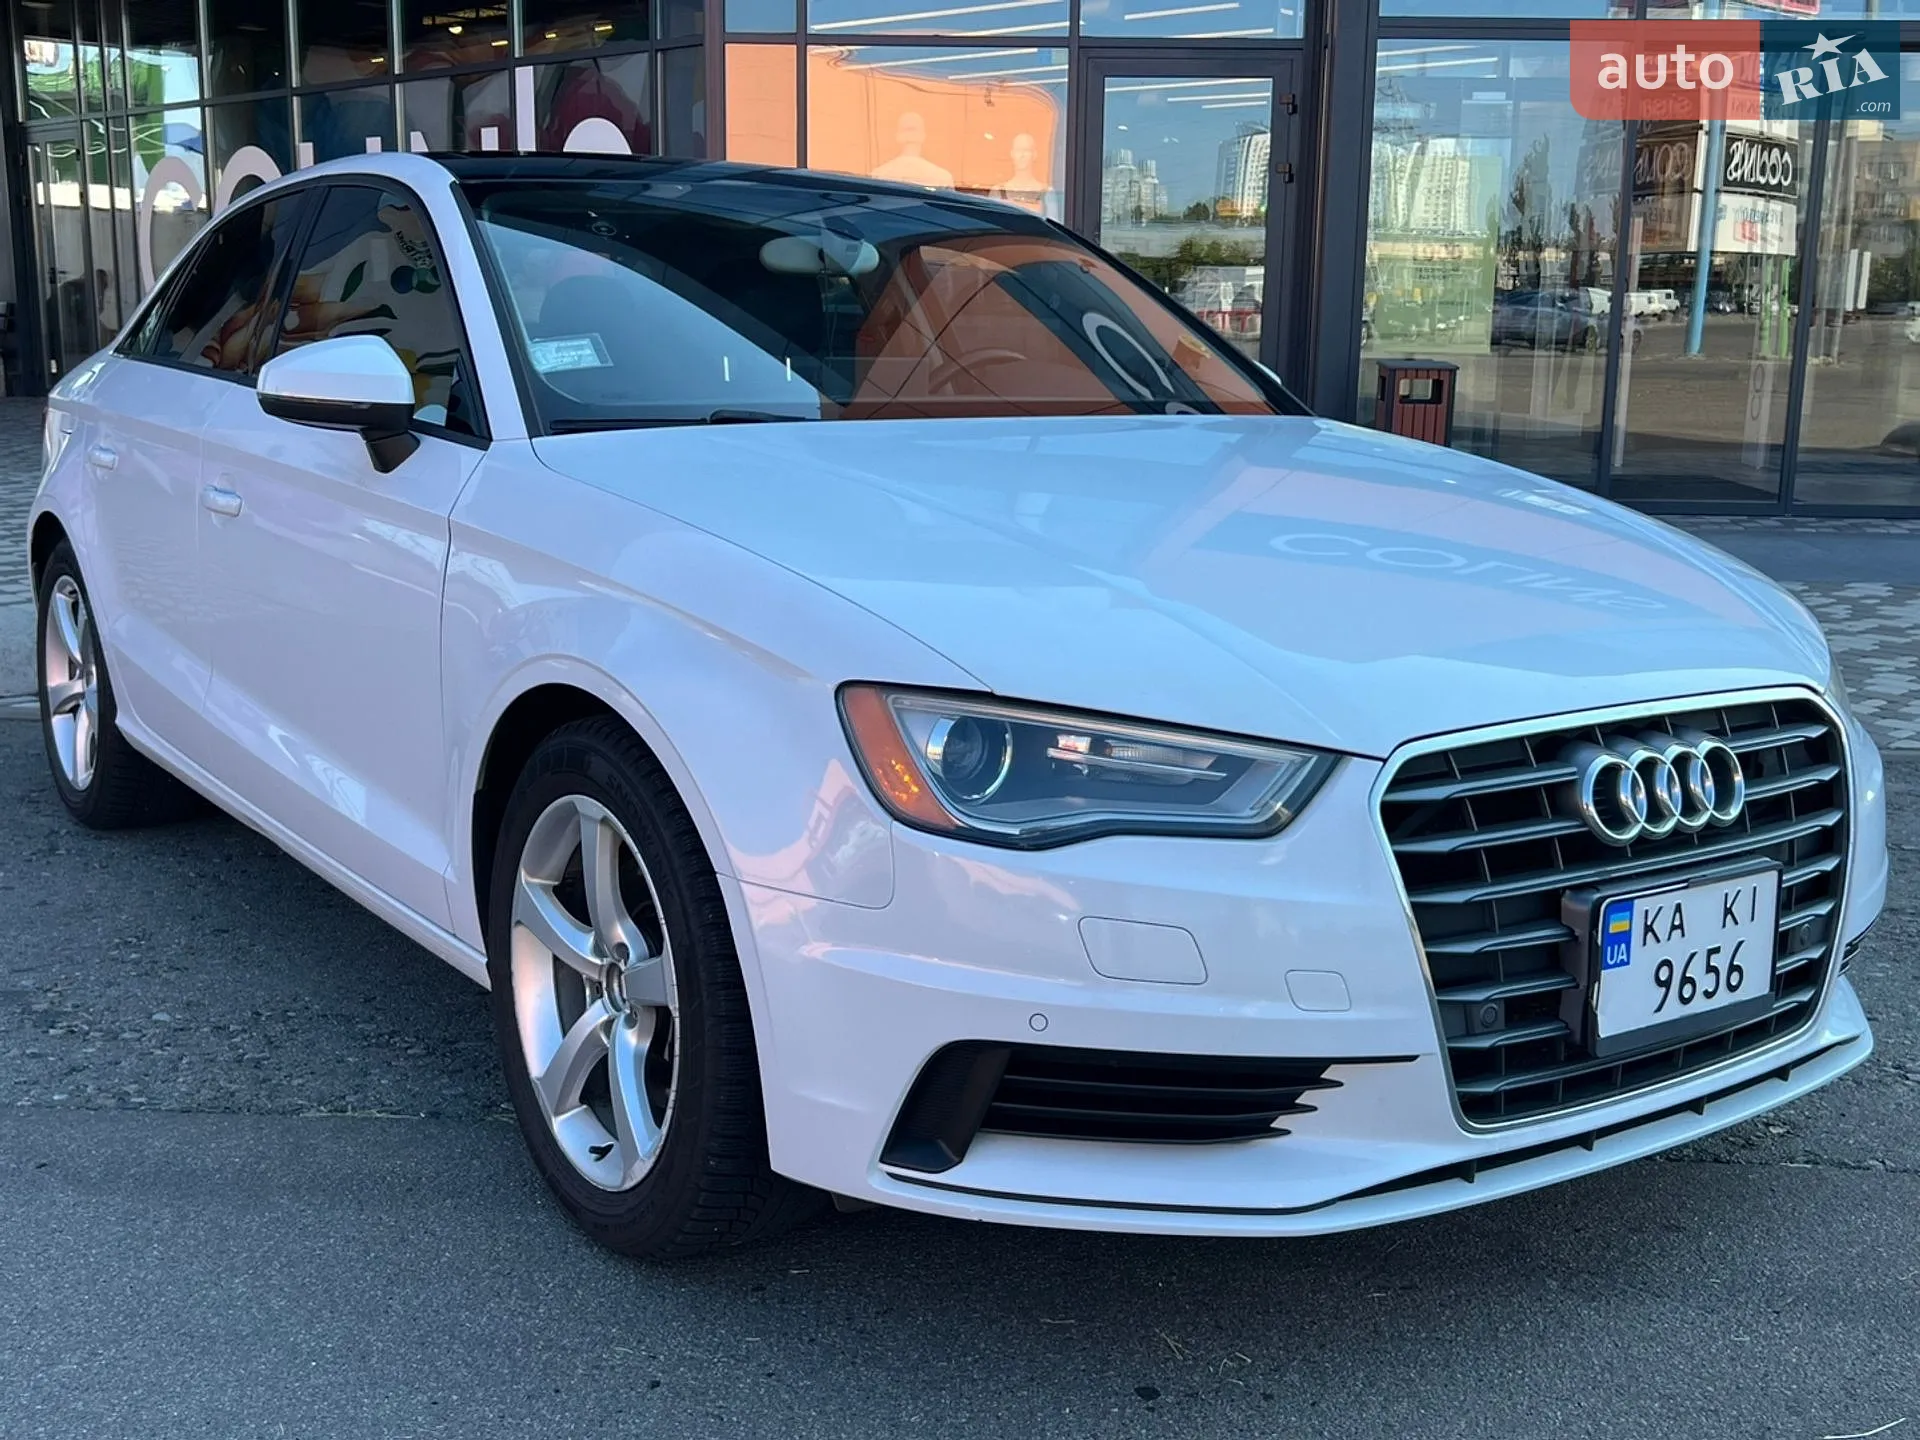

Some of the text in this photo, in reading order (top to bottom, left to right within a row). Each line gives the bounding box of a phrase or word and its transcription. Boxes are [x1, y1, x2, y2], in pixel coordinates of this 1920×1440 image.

[1643, 885, 1758, 946] KA KI
[1607, 944, 1627, 965] UA
[1654, 940, 1745, 1013] 9656
